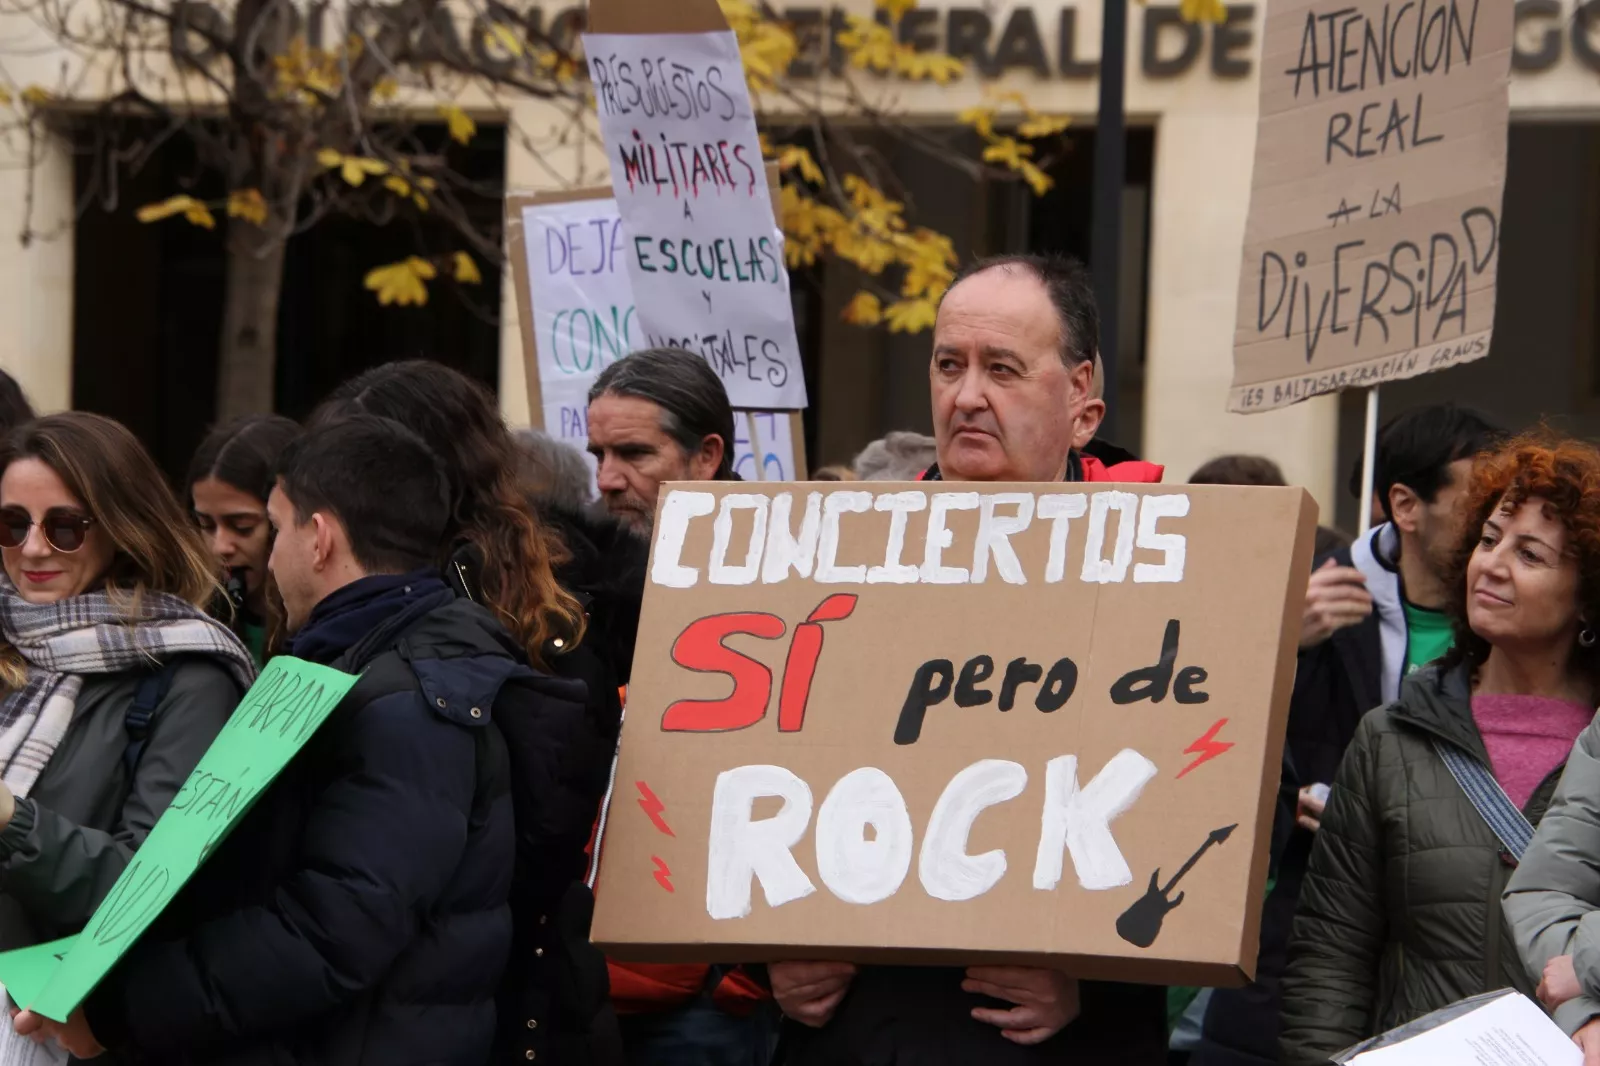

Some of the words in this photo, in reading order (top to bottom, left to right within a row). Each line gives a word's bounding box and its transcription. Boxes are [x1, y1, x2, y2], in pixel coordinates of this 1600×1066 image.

[1142, 4, 1254, 79] DE
[1284, 0, 1480, 99] ATENCION
[1325, 92, 1445, 164] REAL
[683, 198, 694, 222] A
[1327, 197, 1362, 229] A
[1368, 182, 1403, 219] LA
[633, 235, 779, 284] ESCUELAS
[702, 289, 713, 315] Y
[1273, 369, 1354, 403] BALTASAR
[651, 491, 1191, 586] CONCIERTOS
[660, 593, 859, 734] SÍ
[893, 654, 1079, 746] pero
[1110, 619, 1210, 705] de
[706, 748, 1158, 920] ROCK
